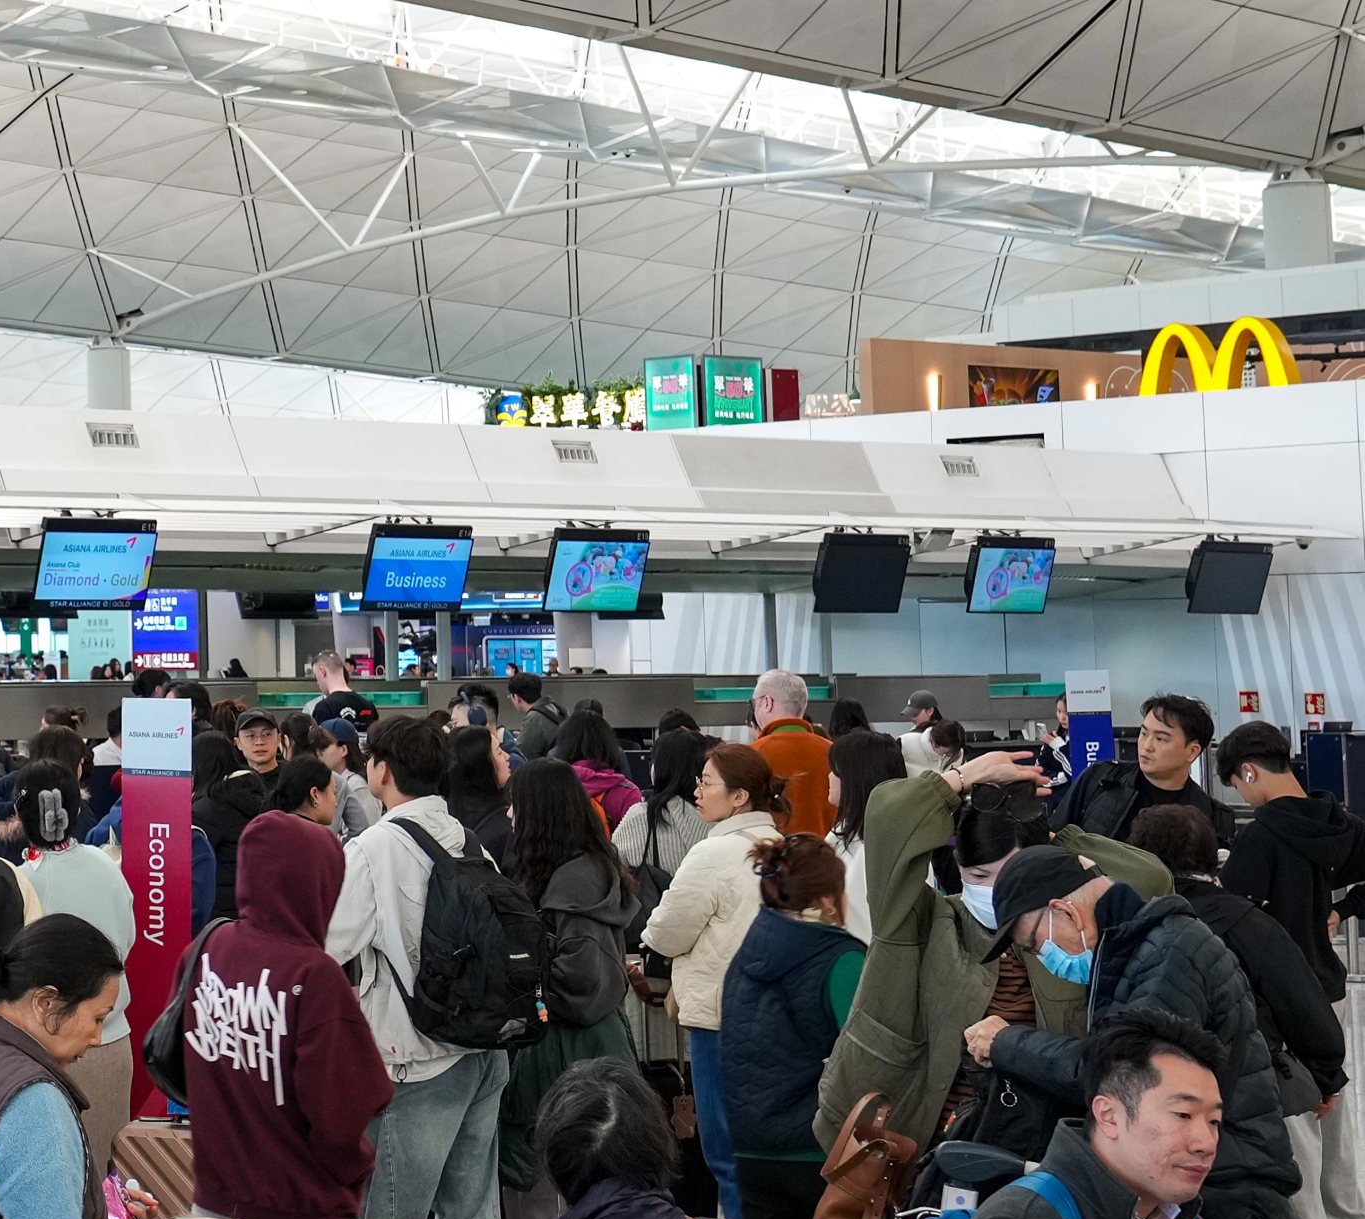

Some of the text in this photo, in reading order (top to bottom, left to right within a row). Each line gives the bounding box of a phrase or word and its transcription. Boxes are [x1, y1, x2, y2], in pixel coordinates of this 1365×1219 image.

[63, 544, 127, 554] ASIANA AIRLINES
[390, 549, 447, 558] ASIANA AIRLINES
[44, 573, 138, 586] Diamond Gold
[386, 572, 447, 588] Business
[152, 731, 178, 739] AIRLINES
[144, 822, 170, 947] Economy
